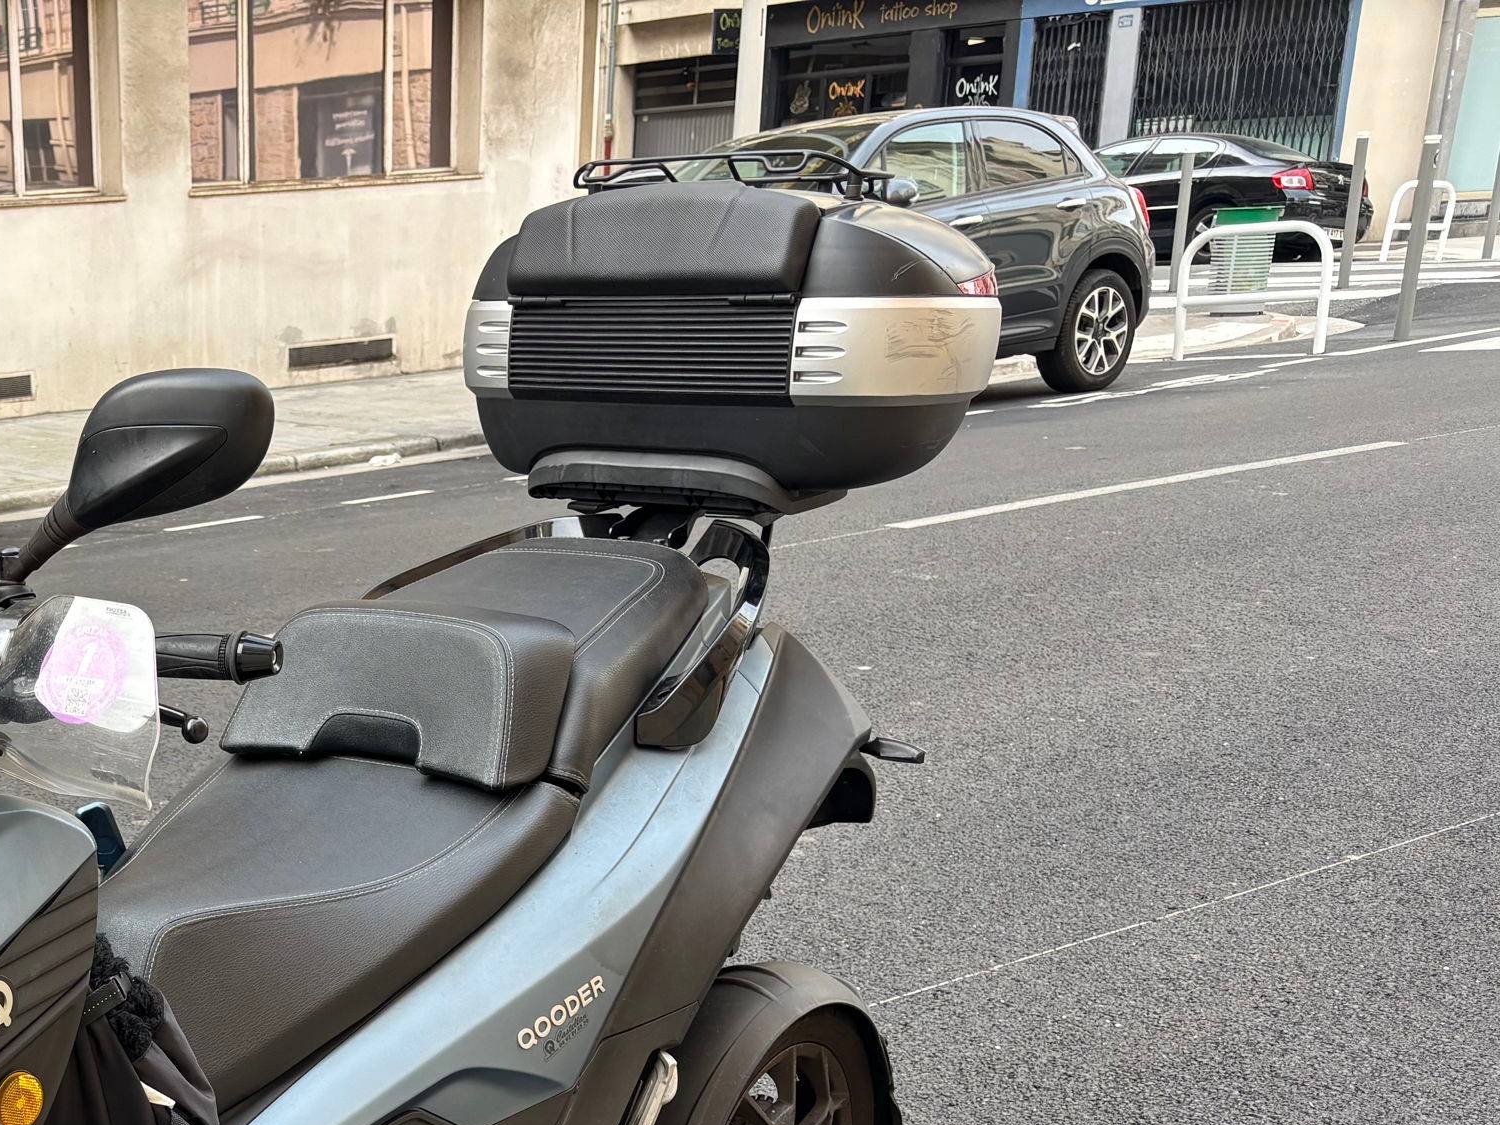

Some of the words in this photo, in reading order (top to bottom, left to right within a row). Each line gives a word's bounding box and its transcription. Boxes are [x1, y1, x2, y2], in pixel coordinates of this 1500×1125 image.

[880, 1, 920, 24] tattoo
[924, 0, 958, 20] shop
[517, 975, 606, 1050] QOODER
